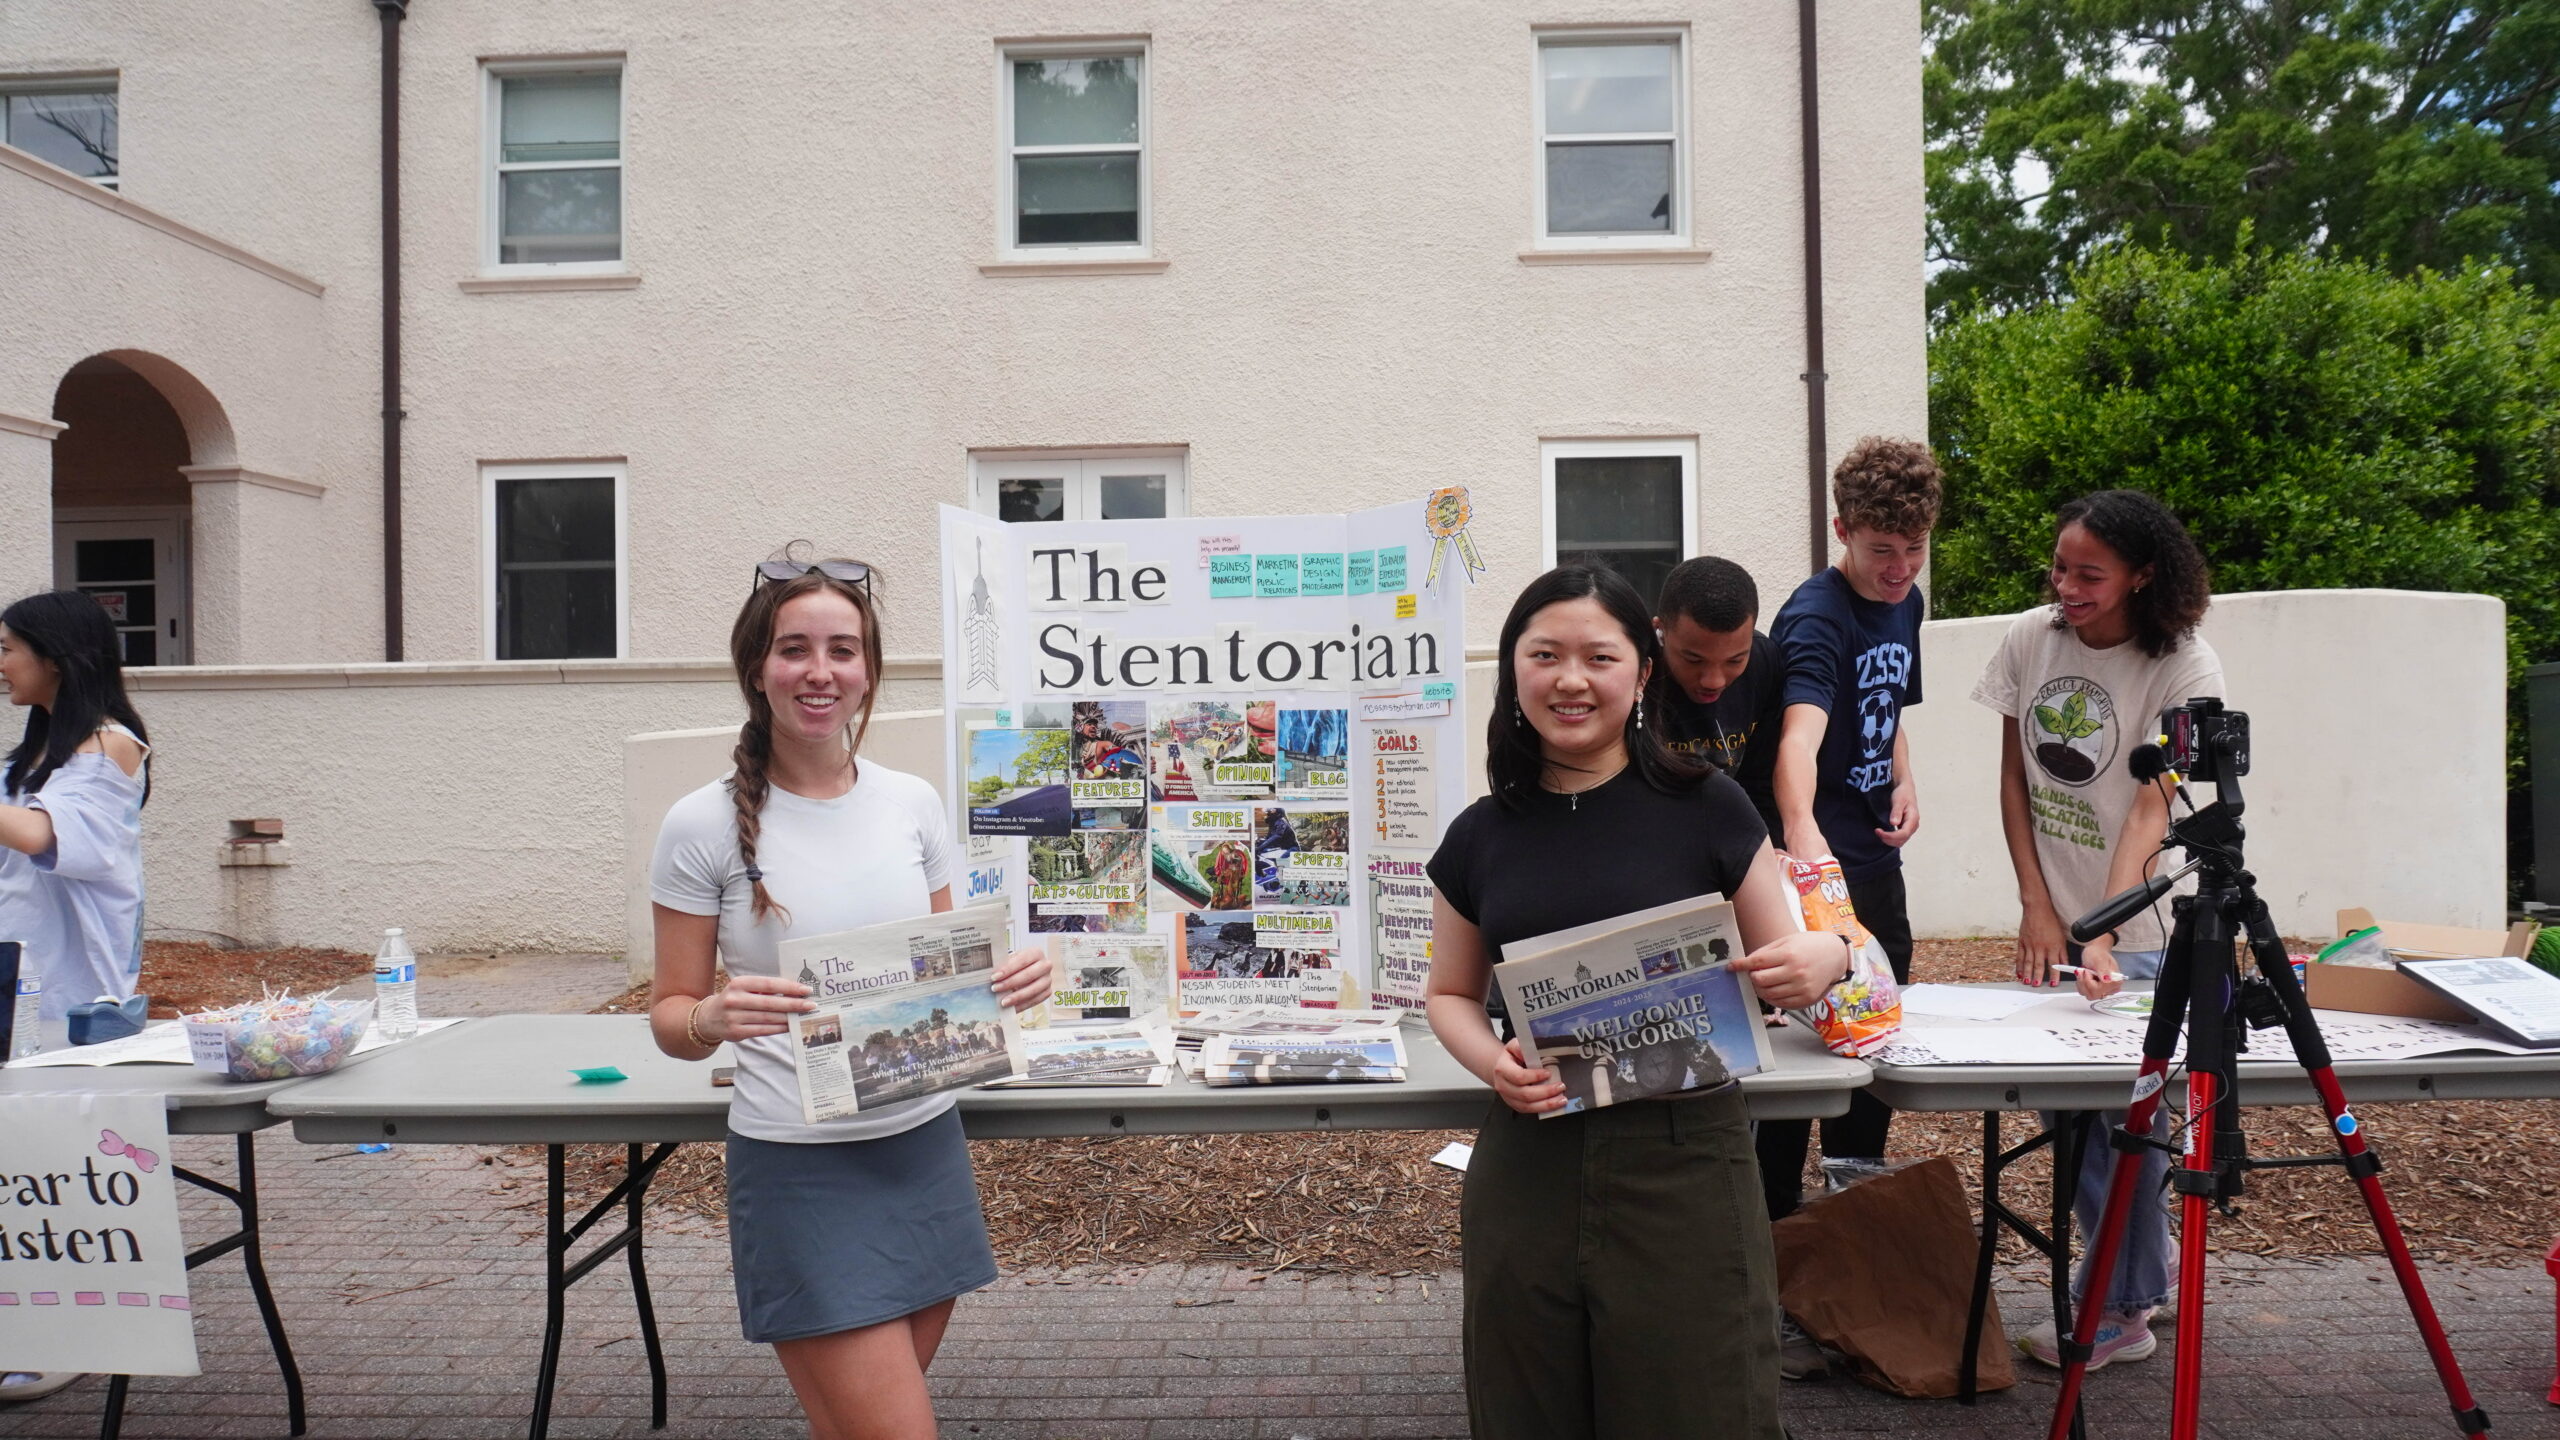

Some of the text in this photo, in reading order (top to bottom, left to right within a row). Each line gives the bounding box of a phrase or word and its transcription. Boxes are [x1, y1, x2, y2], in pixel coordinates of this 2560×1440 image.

[1211, 561, 1250, 573] BUSINESS
[1256, 559, 1298, 571] MARKETING
[1303, 557, 1341, 566] GRAPHIC
[1032, 548, 1167, 602] The
[1212, 575, 1252, 585] MANAGEMENT
[1303, 568, 1341, 578] DESIGN
[1256, 578, 1286, 587] PUBLIC
[1263, 586, 1298, 595] RELATIONS
[1039, 624, 1442, 689] Stentorian
[1425, 686, 1451, 696] website
[1377, 735, 1418, 752] GOALS
[1216, 764, 1271, 782] OPINION
[1376, 758, 1385, 775] 1
[1310, 771, 1346, 787] BLOG
[1376, 778, 1385, 796] 2
[1073, 781, 1141, 798] FEATURES
[1376, 798, 1386, 819] 3
[983, 816, 1011, 824] Instagram
[1192, 811, 1244, 828] SATIRE
[1376, 821, 1387, 841] 4
[2040, 820, 2066, 840] ALL
[2070, 830, 2106, 851] AGES
[1293, 852, 1344, 868] SPORTS
[1375, 861, 1425, 877] PIPELINE:
[1382, 882, 1433, 898] WELCOME DA
[1257, 914, 1333, 931] MULTIMEDIA
[1385, 927, 1411, 940] FORUM
[820, 956, 855, 976] The
[1385, 956, 1408, 970] JOIN
[824, 969, 910, 997] Stentorian
[1182, 979, 1291, 991] NCSSM STUDENTS MEET
[1385, 970, 1421, 983] MEETINGS
[1301, 983, 1337, 992] Stentorian
[1519, 977, 1557, 999] THE
[1523, 967, 1640, 1013] STENTORIAN
[1054, 990, 1128, 1007] SHOUT-OUT
[1183, 995, 1227, 1006] INCOMING
[1229, 994, 1253, 1005] CLASS
[1255, 995, 1264, 1005] AT
[1371, 992, 1413, 1009] MASTHEAD
[1572, 994, 1708, 1043] WELCOME
[1578, 1014, 1713, 1061] UNICORNS
[872, 1068, 899, 1080] Where
[901, 1065, 910, 1074] In
[912, 1061, 927, 1071] The
[928, 1055, 953, 1068] World
[955, 1050, 970, 1060] Did
[2192, 1091, 2202, 1138] JOILAN
[79, 1156, 139, 1206] to
